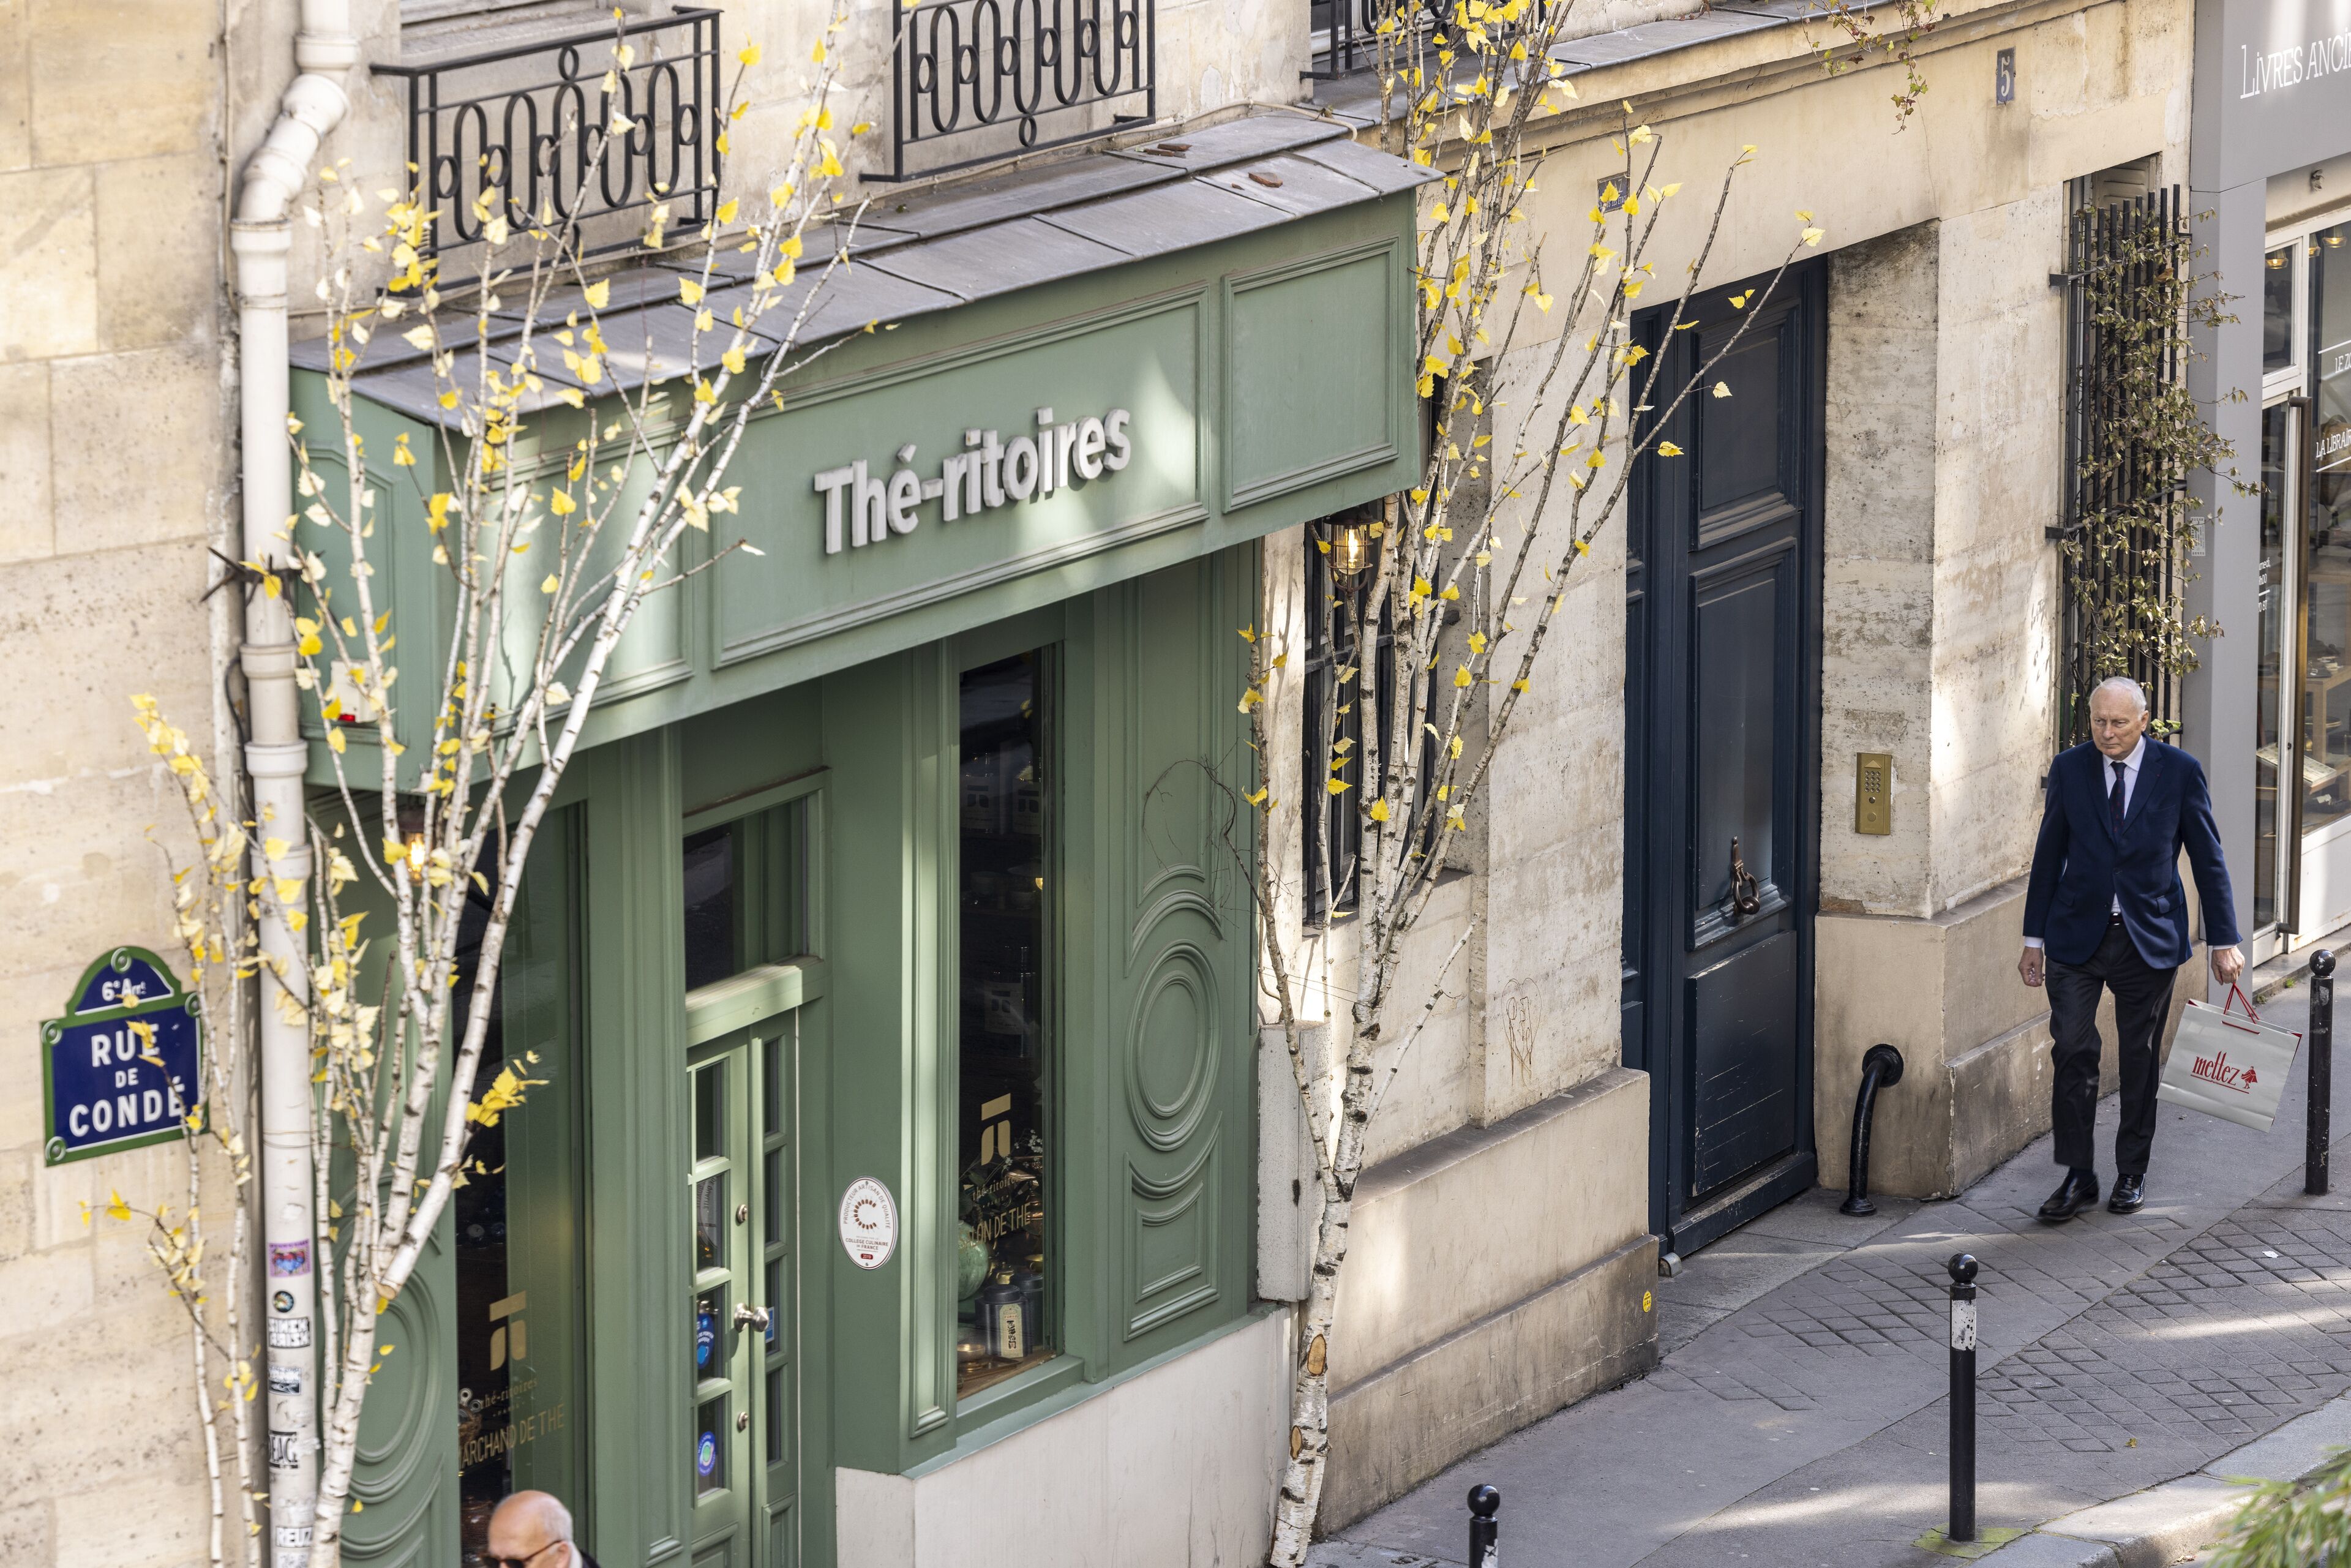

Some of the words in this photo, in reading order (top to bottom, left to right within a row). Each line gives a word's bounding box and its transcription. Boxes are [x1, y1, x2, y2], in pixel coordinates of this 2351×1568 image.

[2001, 56, 2011, 97] 5
[2316, 440, 2326, 459] LA
[814, 407, 1131, 554] Thé-ritoires
[91, 1024, 160, 1067] RUE
[115, 1068, 139, 1089] DE
[69, 1076, 185, 1138] CONDÉ
[858, 1184, 880, 1196] ARTISAN
[994, 1212, 1007, 1238] DE
[520, 1415, 536, 1445] DE
